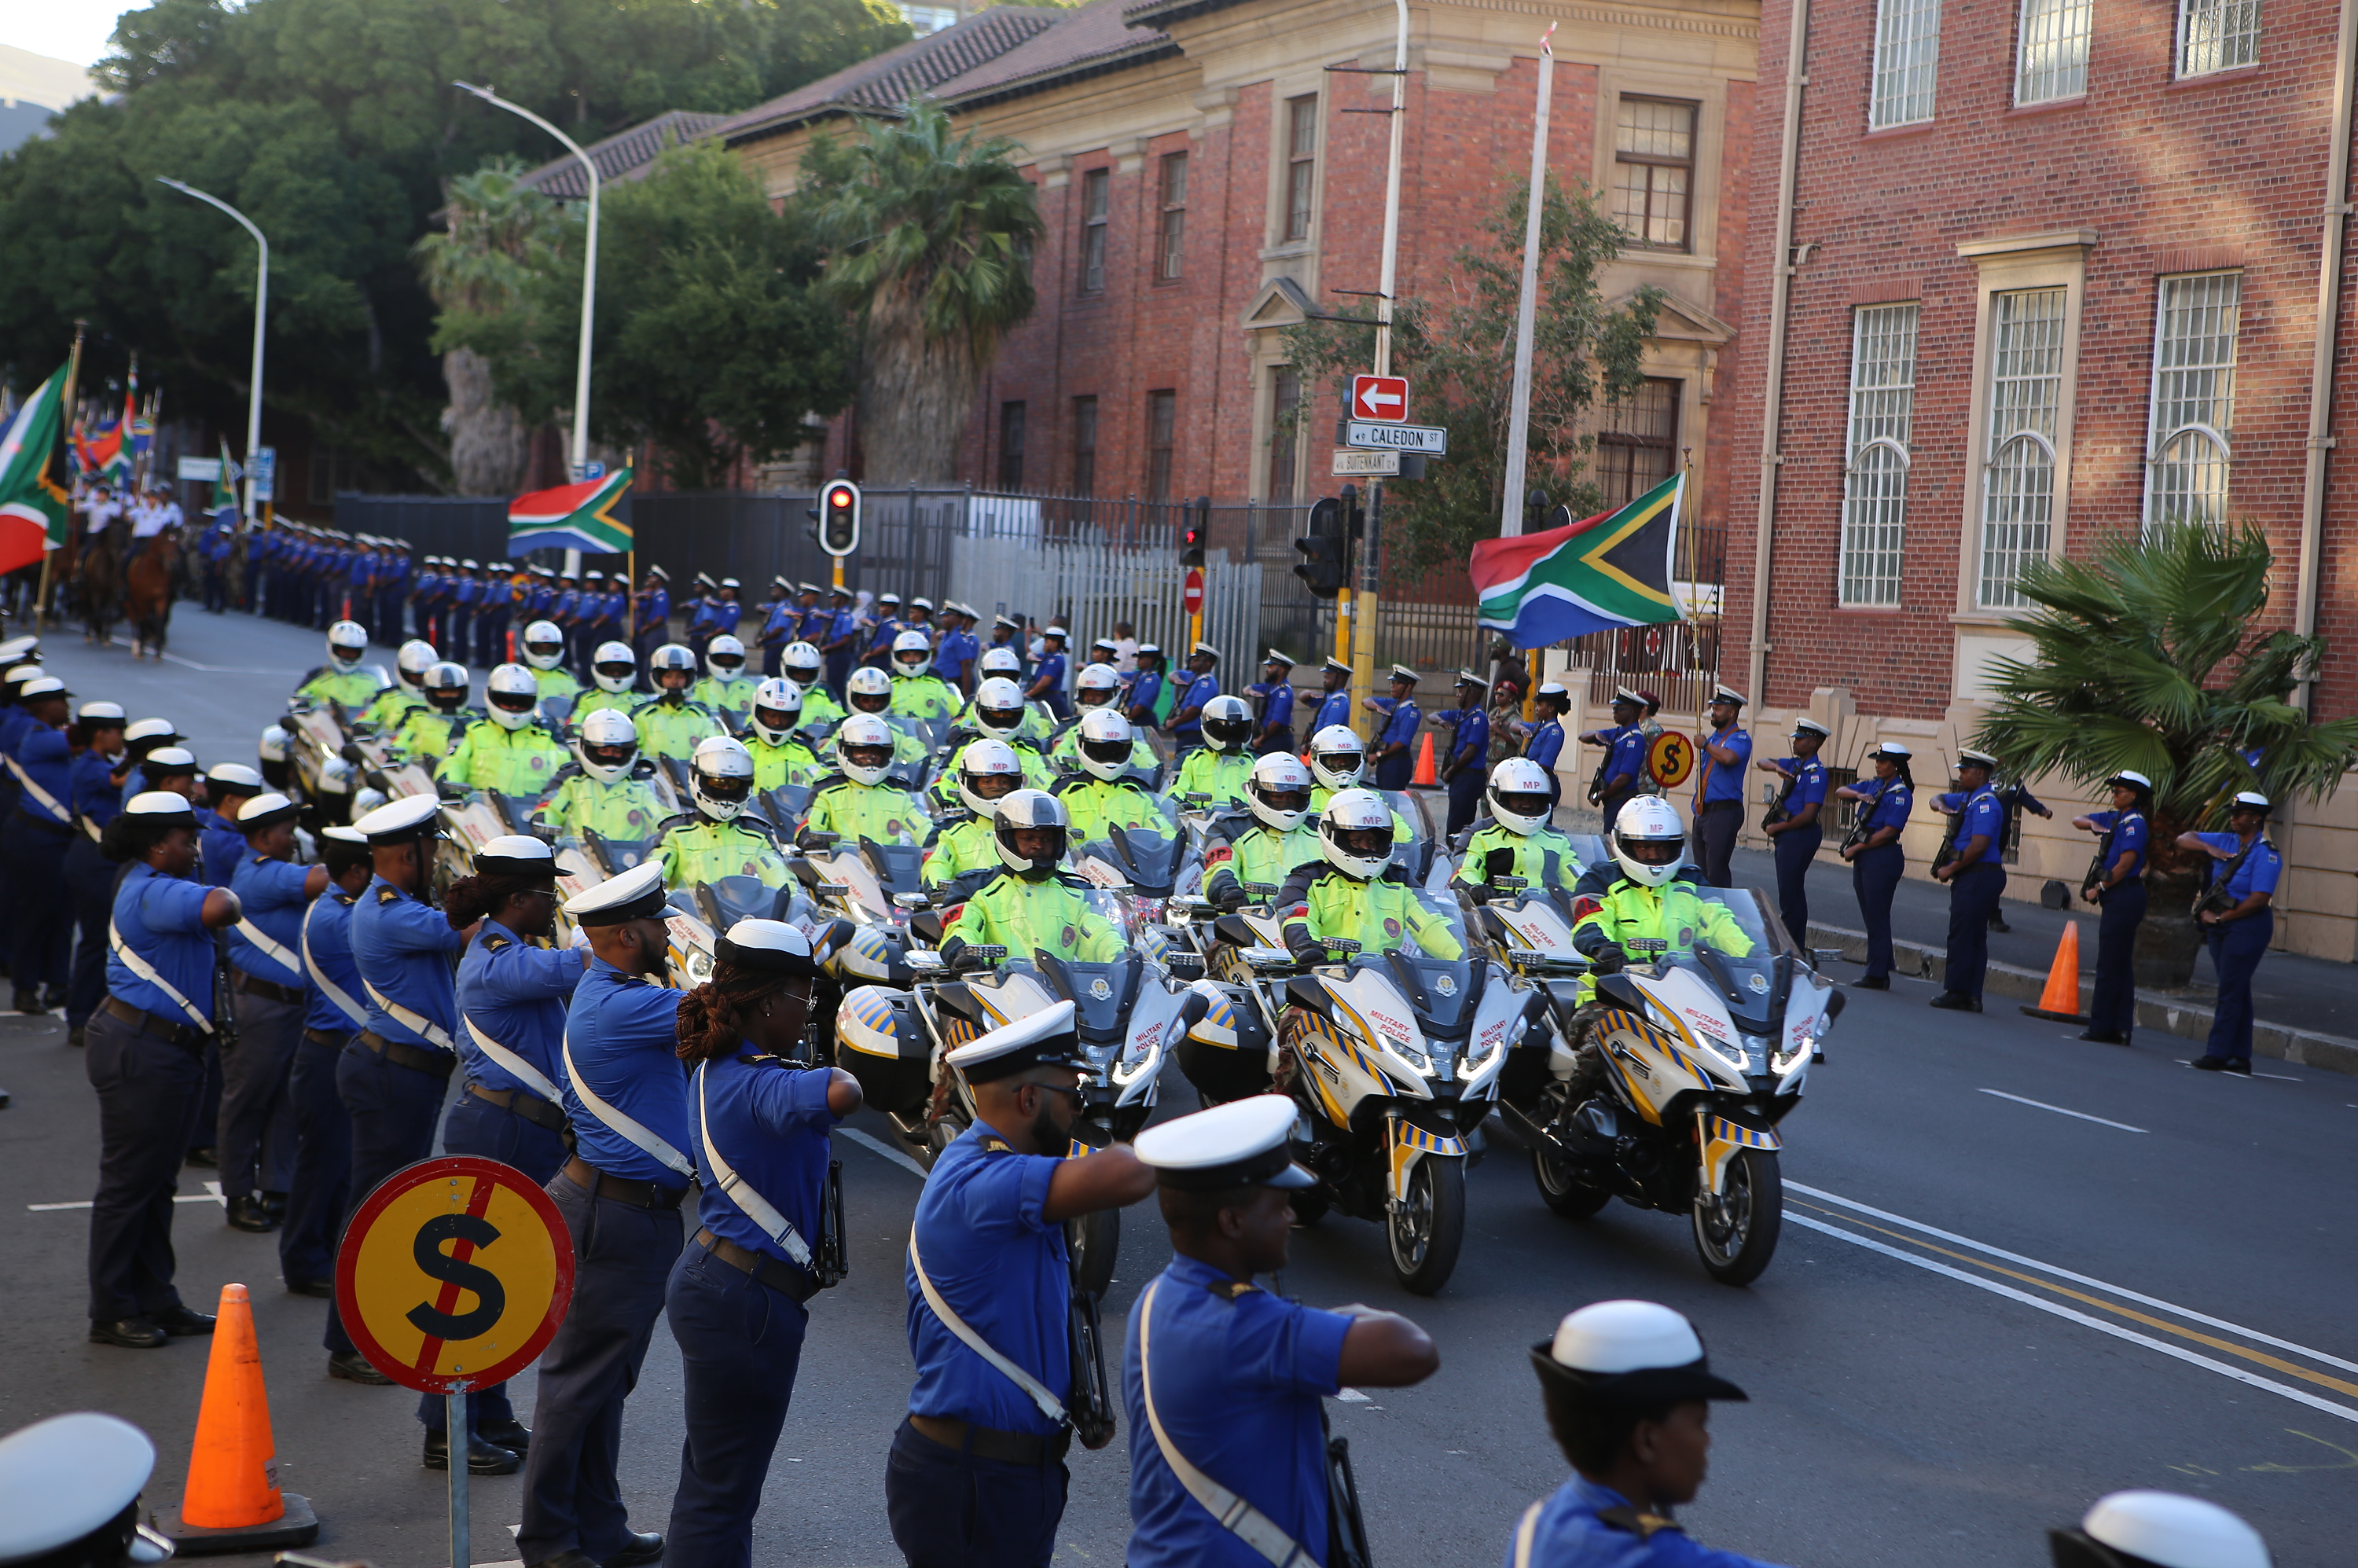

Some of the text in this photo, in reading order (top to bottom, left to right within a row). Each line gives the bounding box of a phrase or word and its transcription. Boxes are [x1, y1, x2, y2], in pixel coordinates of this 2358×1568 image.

[1372, 428, 1423, 446] CALEDON
[1429, 433, 1438, 442] ST
[1650, 824, 1664, 833] MP
[1090, 865, 1114, 885] MILITARY
[1185, 870, 1200, 890] MILITARY
[667, 920, 687, 941] POLICE
[675, 917, 701, 943] MILITARY
[1520, 924, 1542, 945] POLICE
[1529, 922, 1557, 948] MILITARY
[1369, 1010, 1411, 1033] MILITARY
[1480, 1019, 1507, 1038] MILITARY
[1684, 1006, 1726, 1030] MILITARY
[1135, 1020, 1163, 1042] MILITARY
[1380, 1023, 1412, 1044] POLICE
[1480, 1032, 1503, 1048] POLICE
[1695, 1020, 1728, 1040] POLICE
[1135, 1034, 1159, 1052] POLICE
[406, 1214, 505, 1341] S
